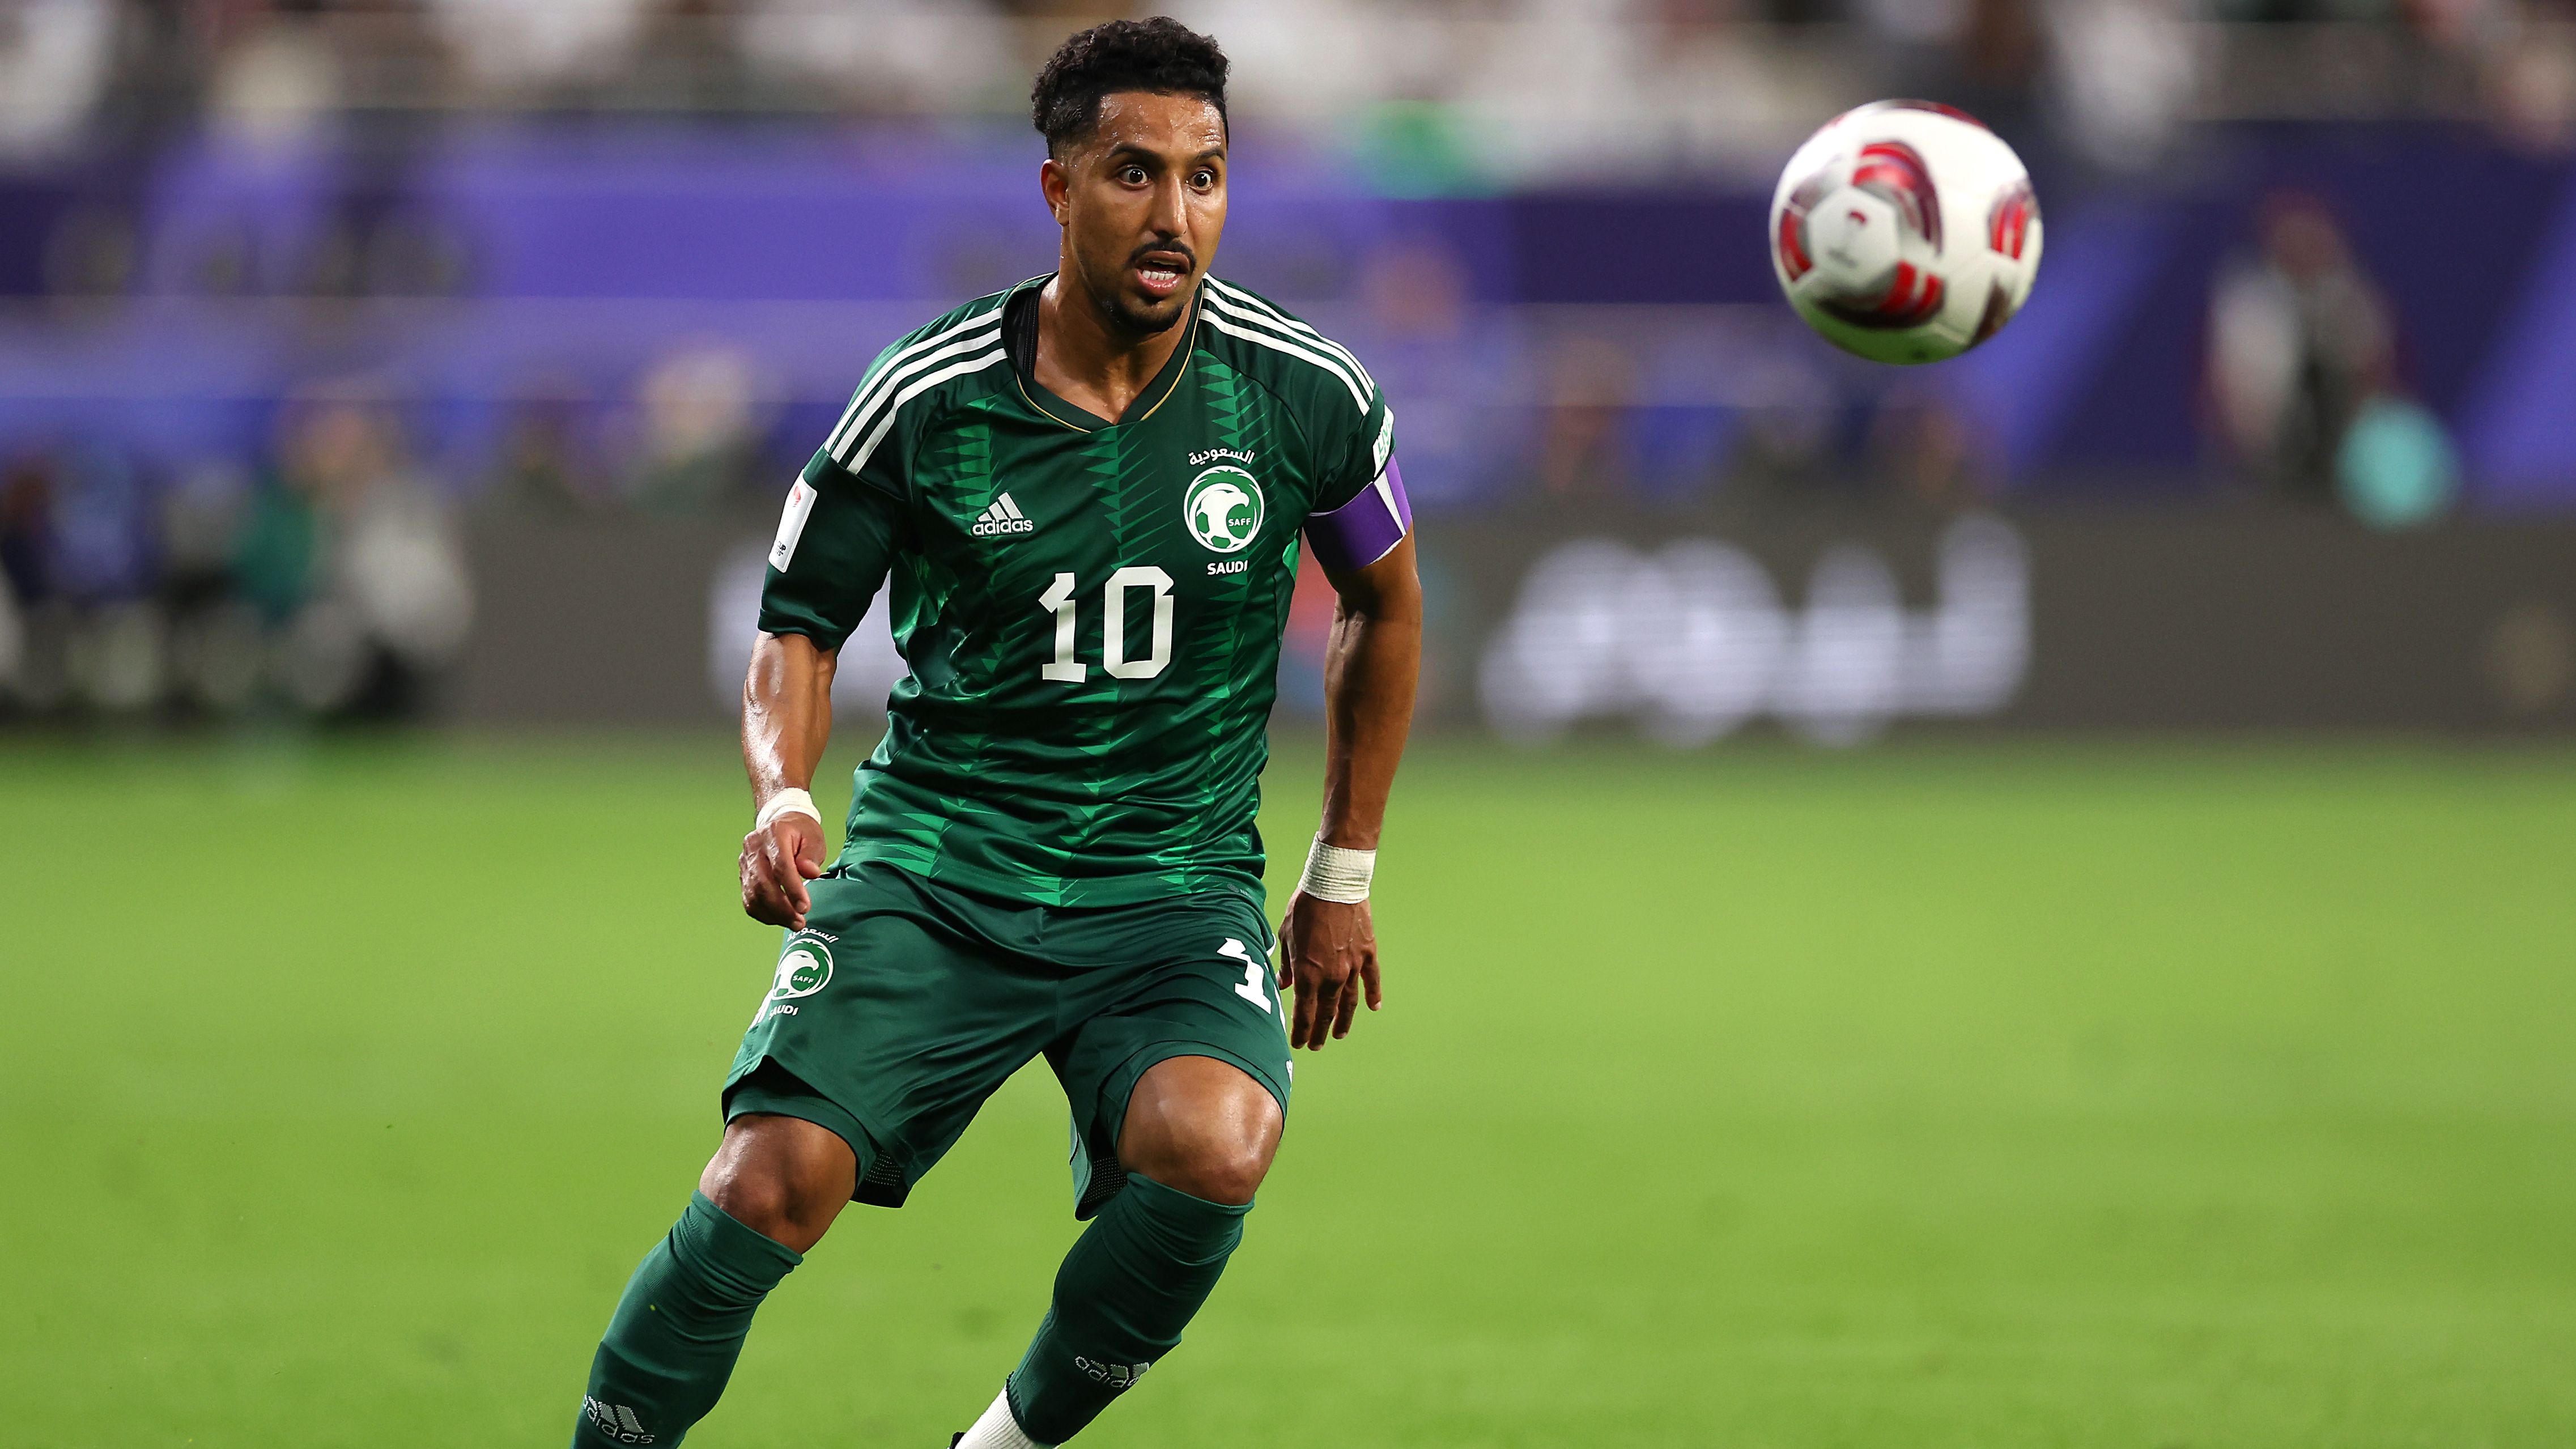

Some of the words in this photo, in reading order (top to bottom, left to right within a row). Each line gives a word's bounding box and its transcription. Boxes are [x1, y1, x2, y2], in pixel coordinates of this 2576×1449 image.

[1188, 448, 1255, 465] السعودية
[972, 518, 1033, 536] adidas
[1228, 518, 1251, 526] SAFF
[1207, 560, 1248, 575] SAUDI
[1038, 566, 1174, 683] 10
[793, 975, 814, 983] SAFF
[1075, 1356, 1140, 1388] adida
